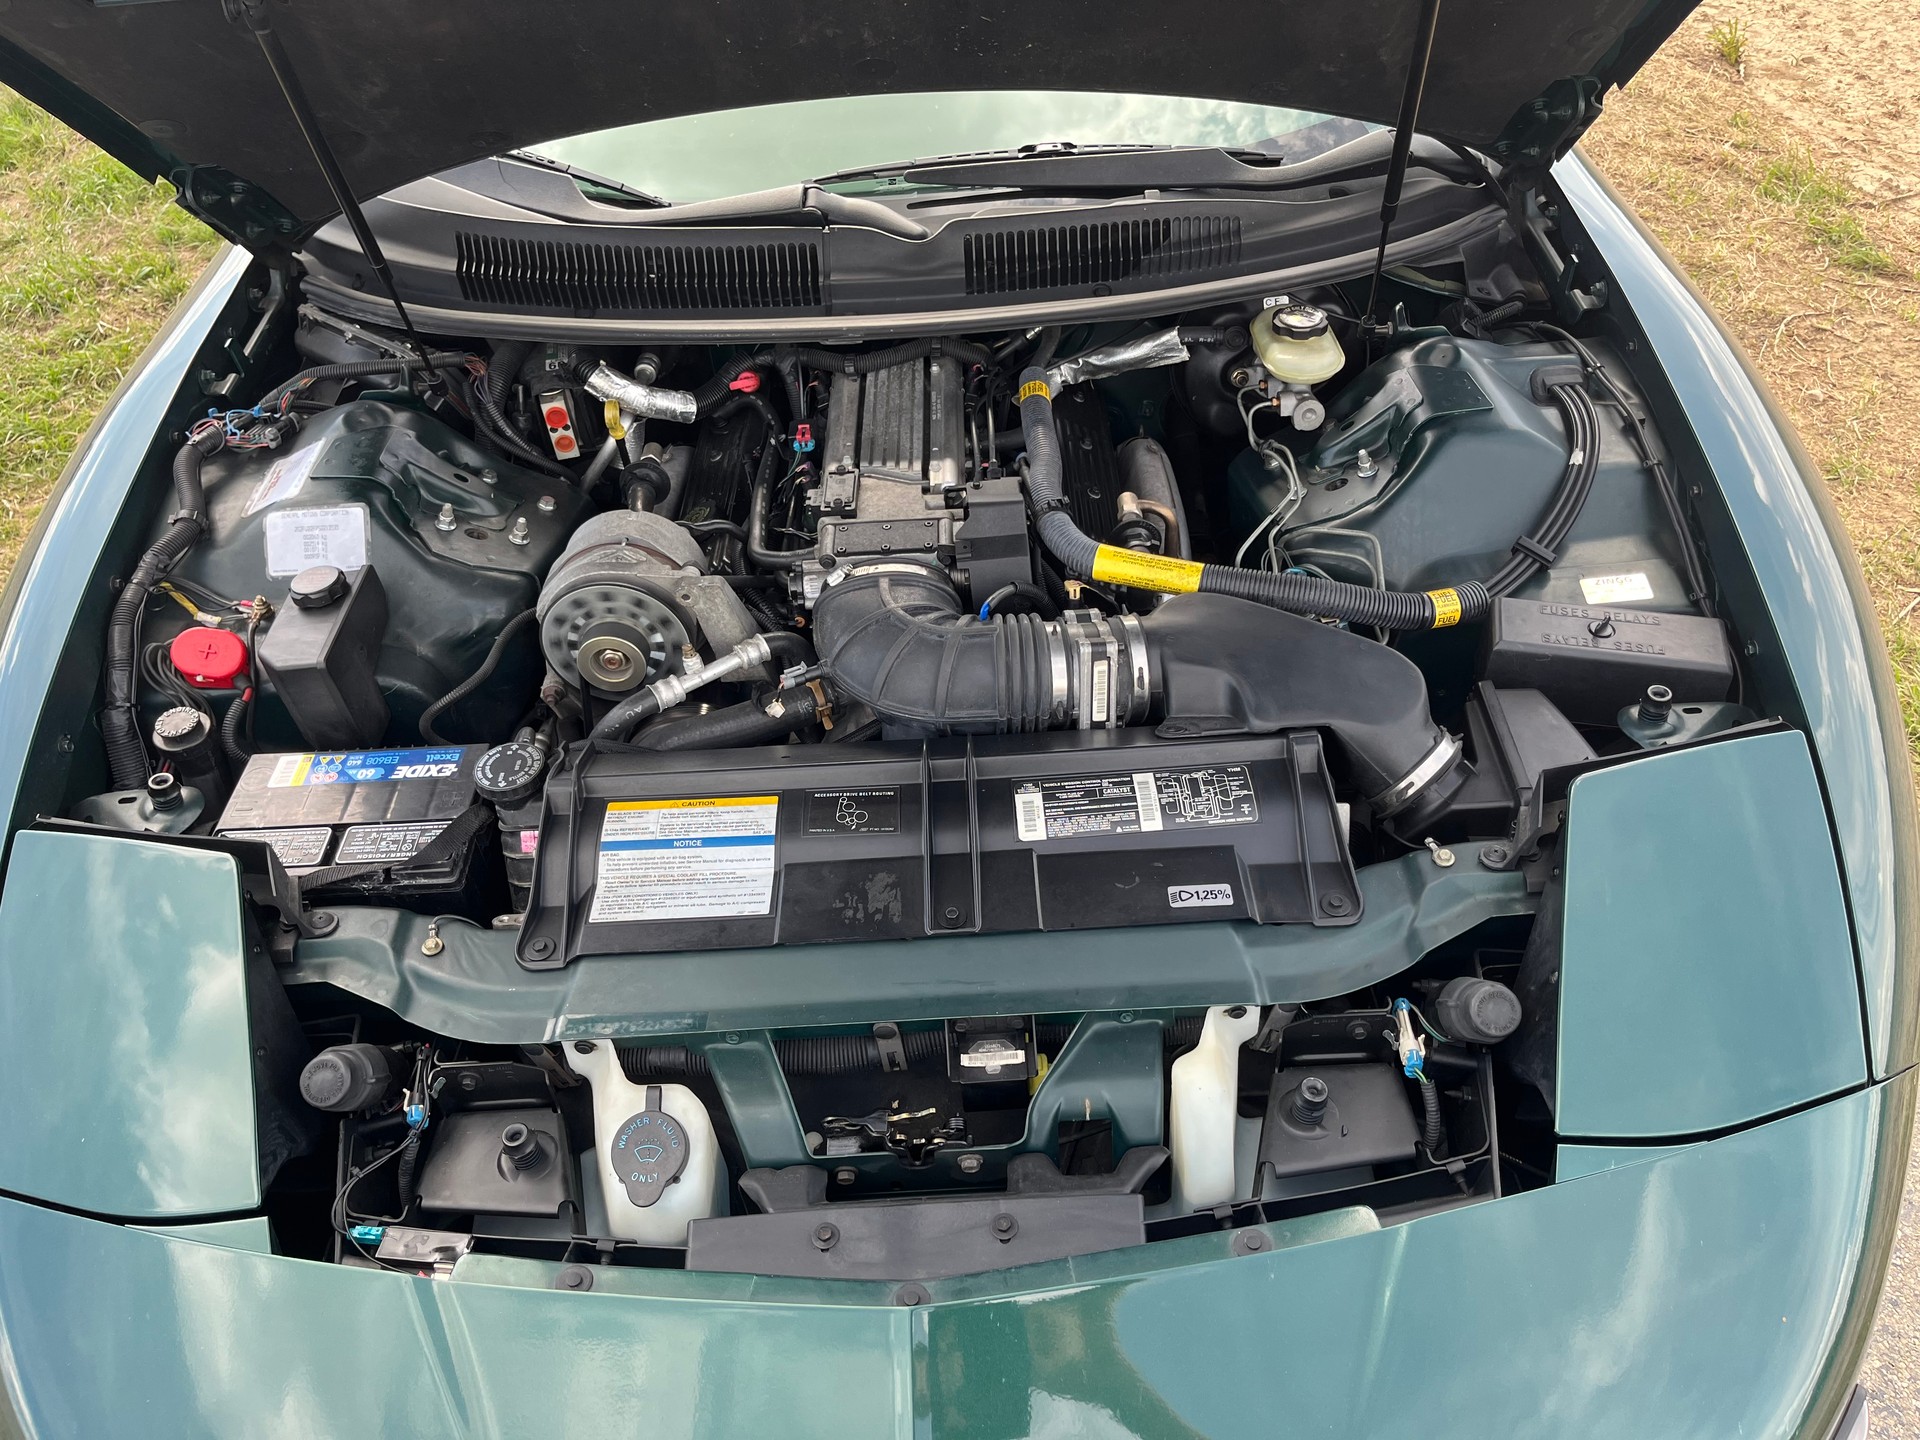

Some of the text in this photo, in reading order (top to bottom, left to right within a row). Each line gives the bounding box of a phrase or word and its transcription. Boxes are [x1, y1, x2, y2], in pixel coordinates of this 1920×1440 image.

[1540, 605, 1590, 618] FUSES
[1438, 616, 1457, 624] FUEL
[1614, 641, 1665, 654] FUSES
[366, 756, 399, 765] EB608
[357, 770, 375, 779] 60
[391, 764, 458, 778] EXIDE
[516, 774, 530, 785] HOT
[356, 851, 417, 859] ANGER/POISON
[1194, 890, 1230, 902] 1,25%
[618, 1117, 679, 1149] WASHER FLUID
[632, 1172, 658, 1183] ONLY
